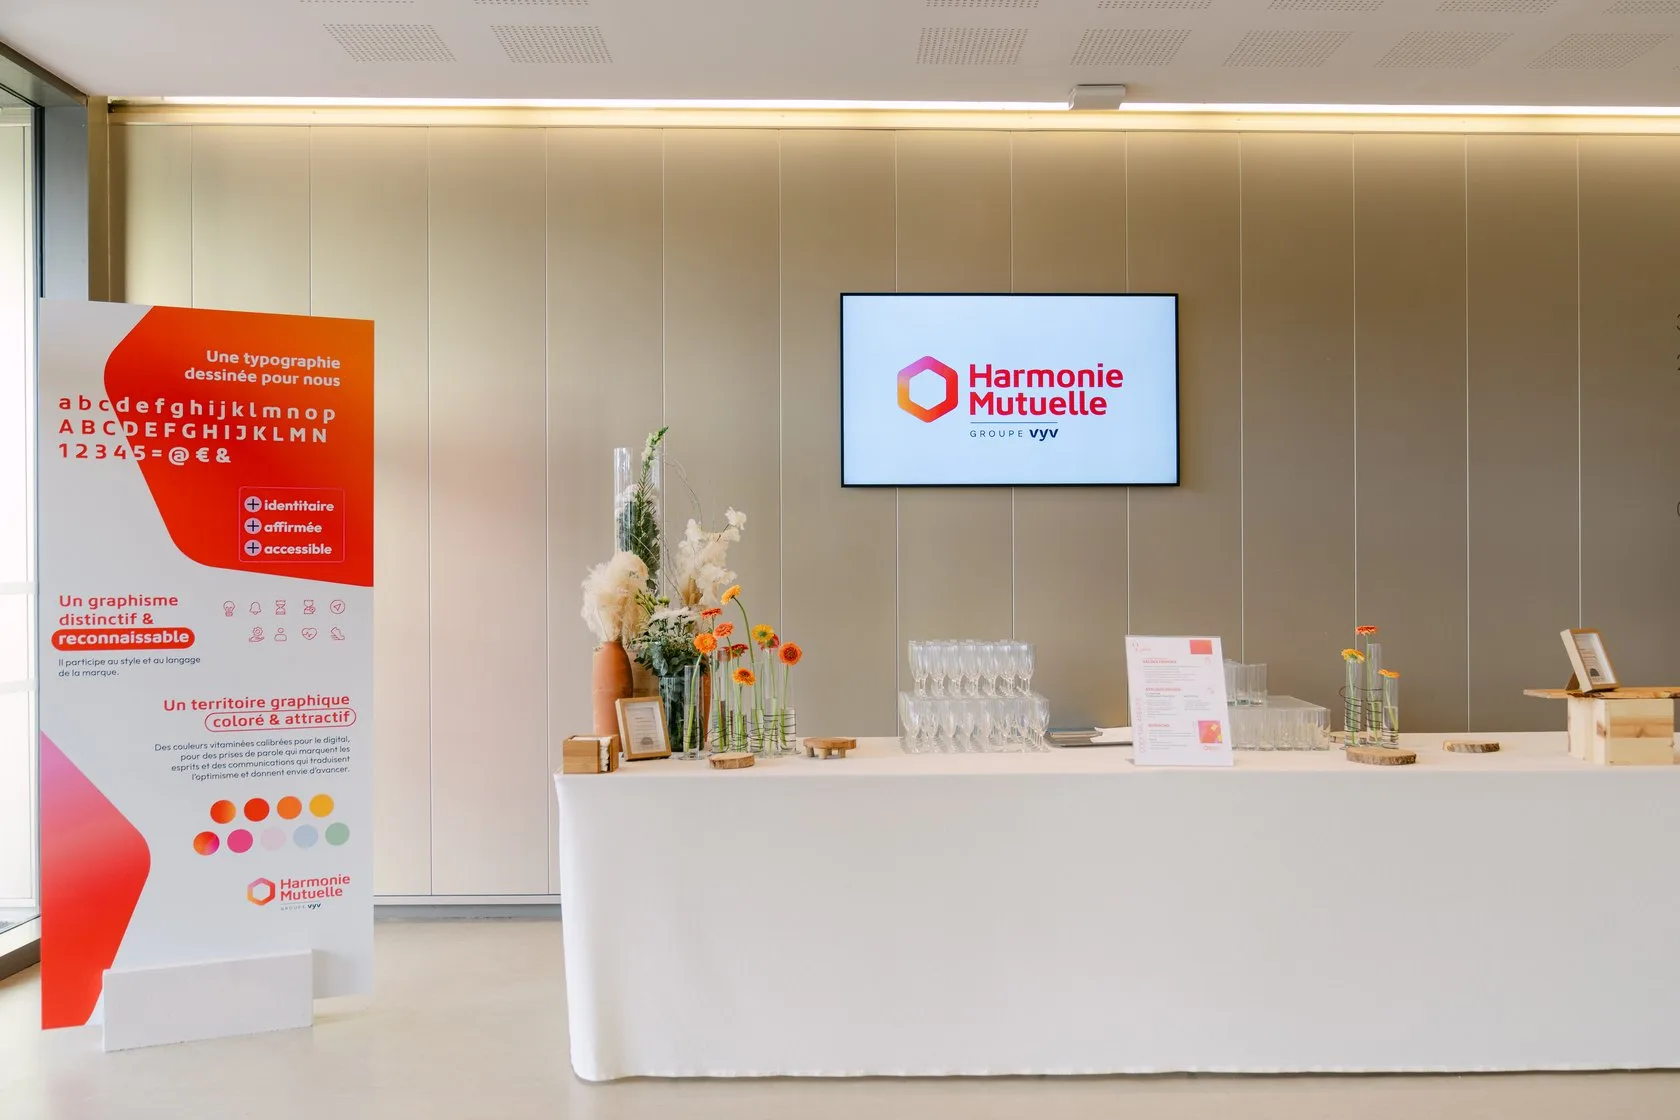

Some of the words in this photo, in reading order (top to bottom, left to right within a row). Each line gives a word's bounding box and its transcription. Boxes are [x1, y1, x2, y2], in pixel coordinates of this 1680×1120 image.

[206, 351, 239, 363] Une
[244, 352, 340, 369] typographie
[185, 368, 257, 383] dessinée
[261, 372, 299, 385] pour
[303, 374, 340, 386] nous
[970, 363, 1123, 387] Harmonie
[970, 391, 1107, 415] Mutuelle
[1030, 429, 1059, 441] vyv
[265, 500, 334, 512] identitaire
[264, 522, 322, 533] affirmée
[264, 543, 332, 554] accessible
[59, 595, 82, 607] Un
[88, 594, 178, 610] graphisme
[59, 613, 137, 625] distinctif
[142, 613, 154, 625] &
[59, 630, 189, 645] reconnaissable
[65, 658, 105, 667] participe
[120, 656, 142, 666] style
[166, 656, 201, 666] langage
[58, 669, 69, 677] de
[72, 669, 80, 677] la
[82, 669, 119, 678] marque.
[164, 699, 185, 711] Un
[191, 697, 266, 710] territoire
[271, 695, 350, 710] graphique
[213, 714, 264, 727] coloré
[270, 714, 280, 725] &
[285, 711, 351, 724] attractif
[155, 743, 171, 751] Des
[173, 742, 208, 750] couleurs
[210, 740, 254, 748] vitaminées
[256, 738, 292, 747] calibrées
[294, 738, 312, 746] pour
[323, 736, 350, 744] digital,
[181, 753, 199, 761] pour
[219, 750, 243, 760] prises
[245, 750, 255, 758] de
[257, 748, 284, 758] parole
[285, 748, 297, 757] qui
[299, 746, 337, 755] marquent
[339, 745, 350, 753] les
[171, 763, 199, 772] esprits
[212, 761, 226, 769] des
[228, 758, 294, 768] communications
[297, 758, 309, 767] qui
[310, 755, 350, 764] traduisent
[251, 769, 285, 777] donnent
[287, 767, 308, 775] envie
[281, 874, 350, 889] Harmonie
[281, 886, 343, 901] Mutuelle
